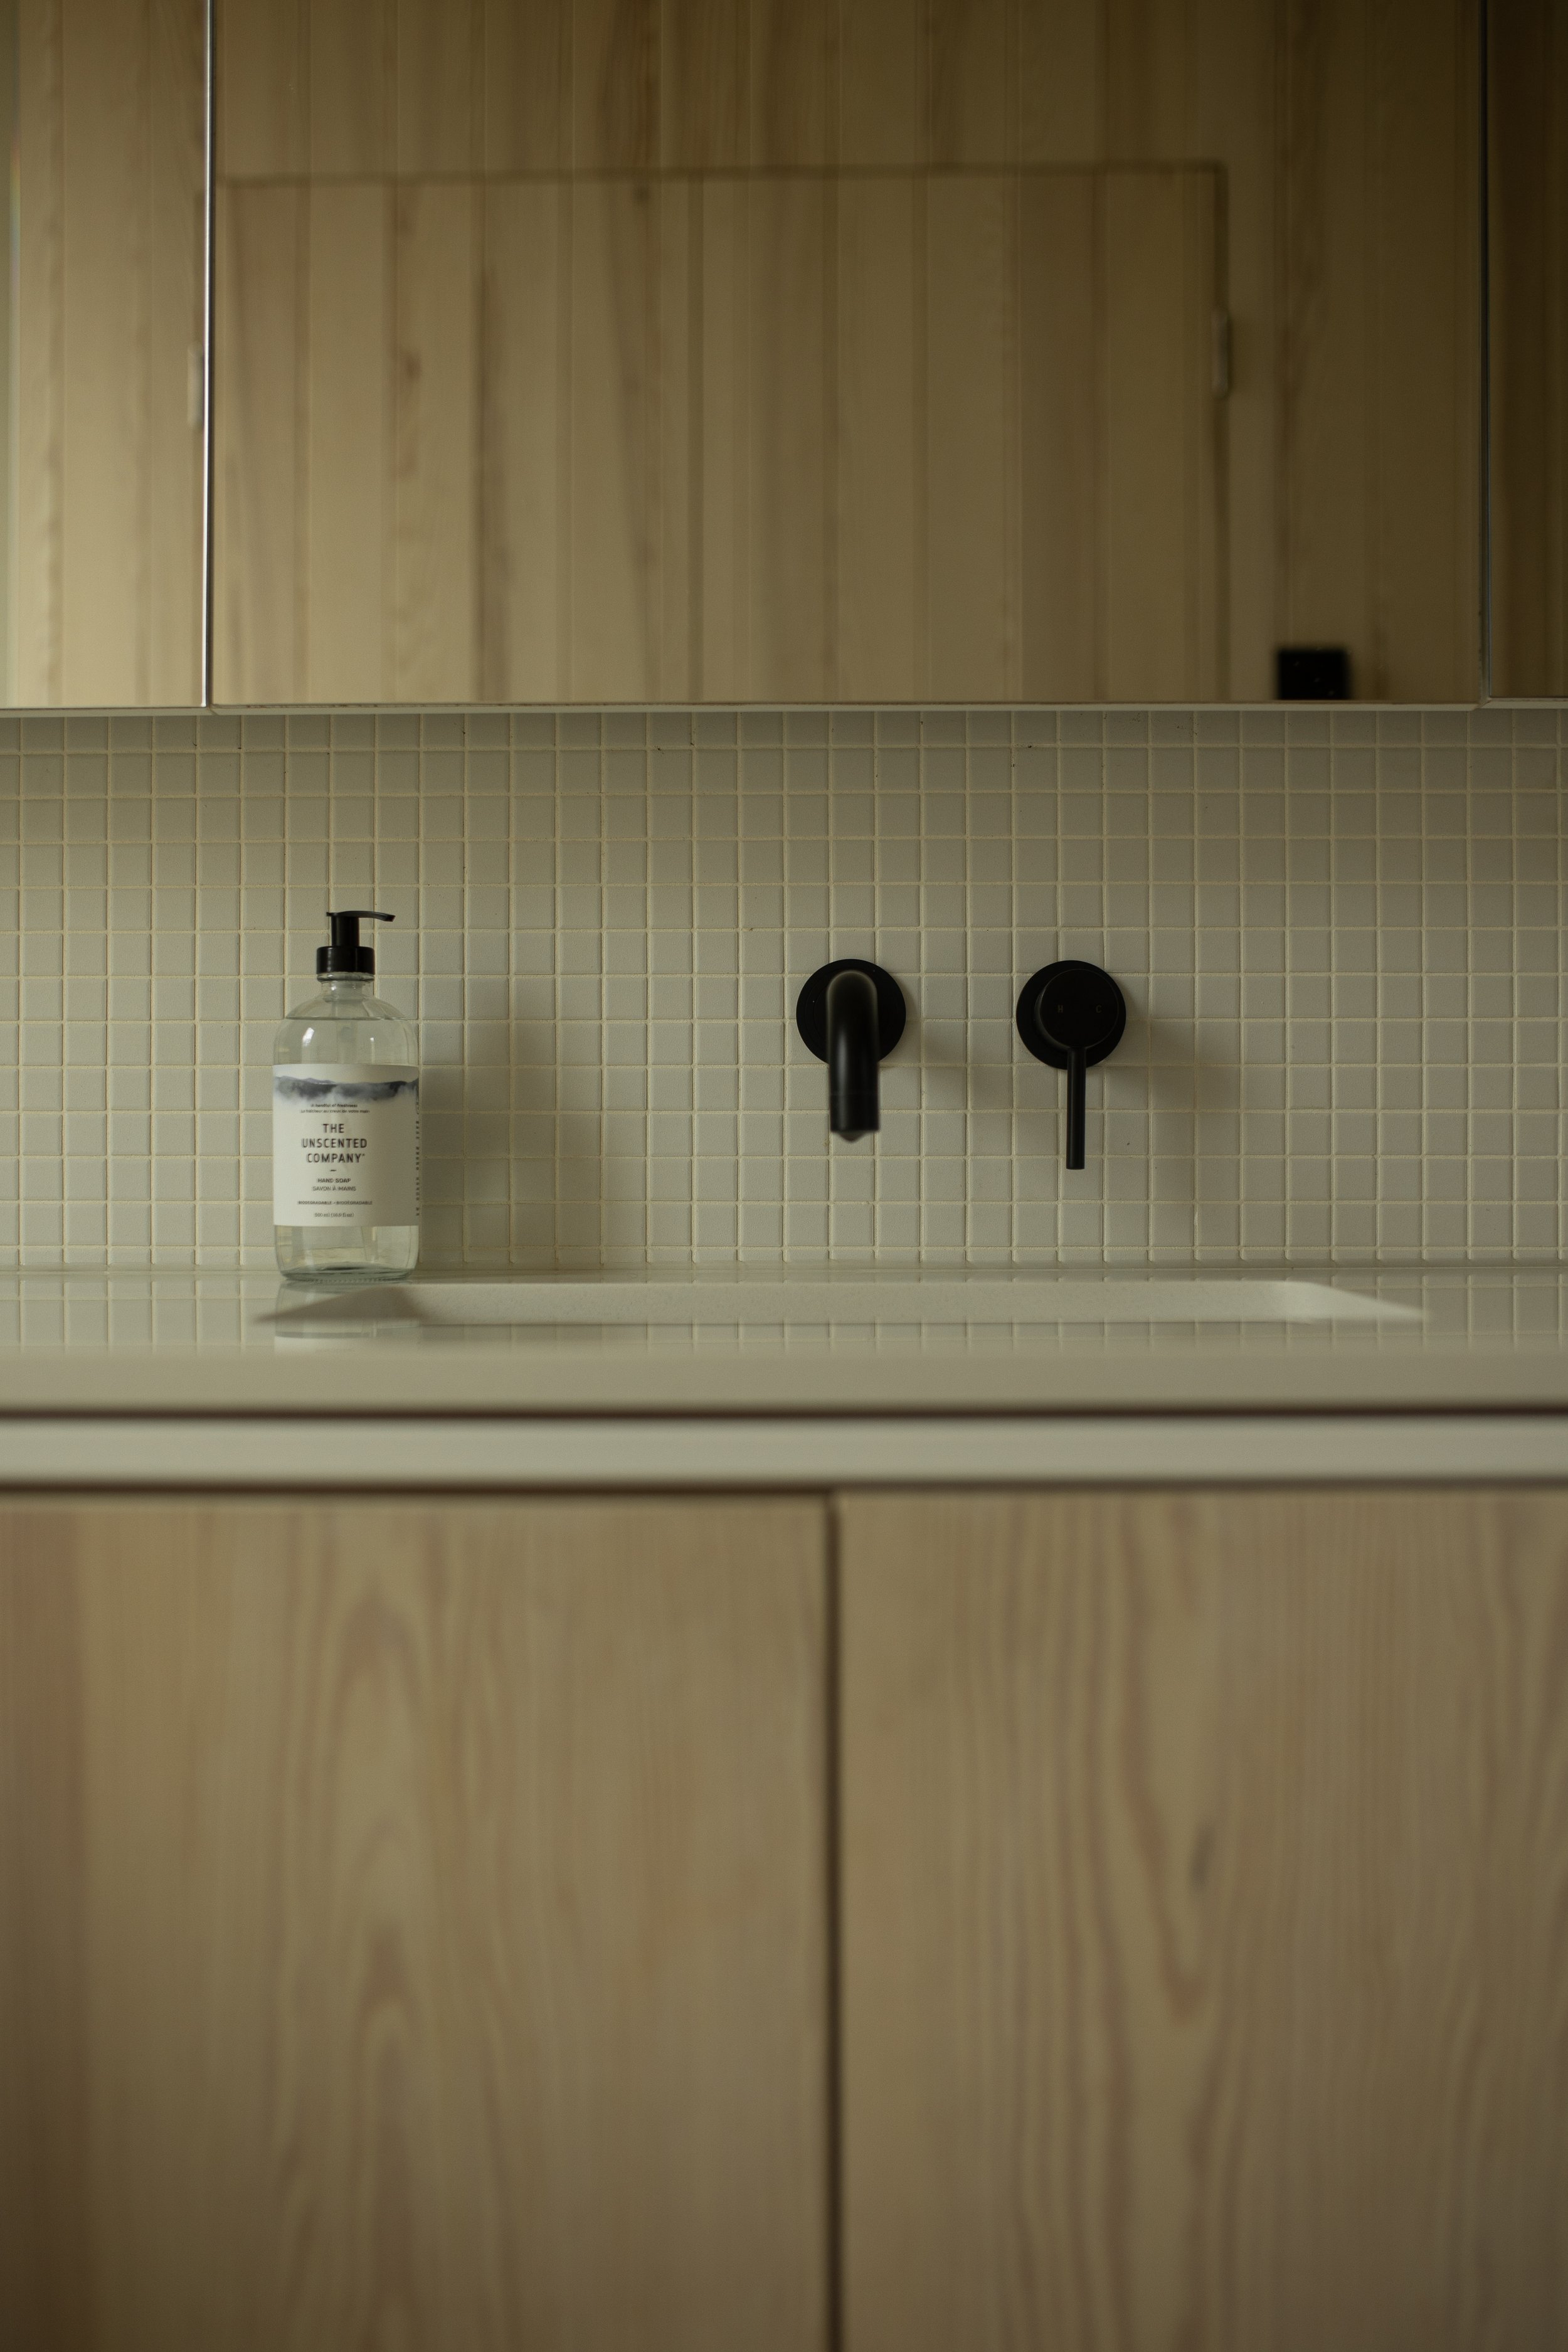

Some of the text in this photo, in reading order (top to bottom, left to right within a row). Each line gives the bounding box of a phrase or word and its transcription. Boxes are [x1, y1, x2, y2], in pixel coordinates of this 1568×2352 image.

[1057, 1005, 1102, 1013] H C
[322, 1123, 344, 1133] THE
[302, 1138, 368, 1148] UNSCENTED
